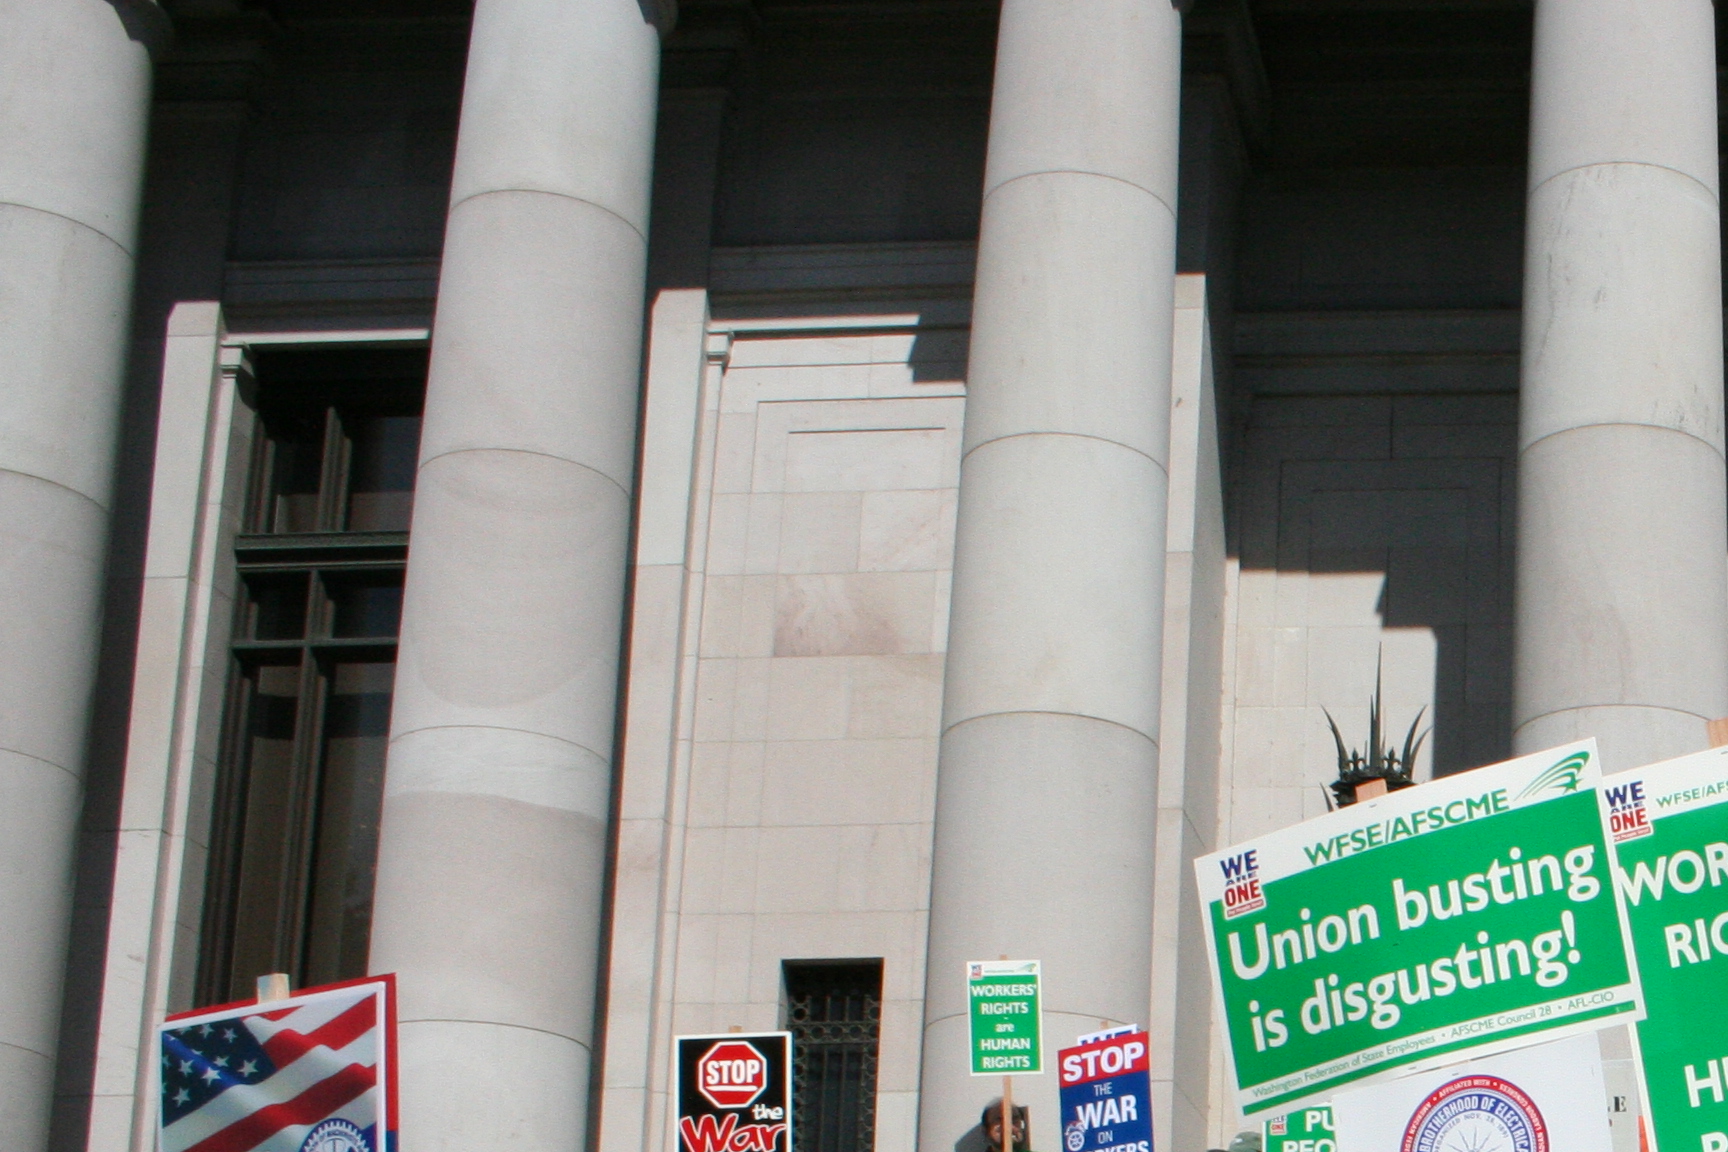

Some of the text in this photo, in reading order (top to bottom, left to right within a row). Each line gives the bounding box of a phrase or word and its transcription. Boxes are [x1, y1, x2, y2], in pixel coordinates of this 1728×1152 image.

[1605, 781, 1645, 809] WE
[1303, 788, 1509, 867] WFSE/AFSCME
[1610, 808, 1648, 834] ONE
[1220, 849, 1259, 879] WE
[1225, 879, 1261, 907] ONE
[1228, 844, 1601, 982] Union busting
[1249, 910, 1581, 1053] is disgusting!
[980, 1002, 1028, 1014] RIGHTS
[1450, 990, 1615, 1039] AFSCME Council 28 AFL-CIO
[995, 1023, 1014, 1032] are
[981, 1038, 1030, 1050] HUMAN
[706, 1059, 760, 1085] STOP
[982, 1056, 1030, 1068] RIGHTS
[1063, 1042, 1144, 1082] STOP
[1304, 1060, 1351, 1083] Federation
[1386, 1034, 1436, 1056] Employees
[1094, 1082, 1112, 1096] THE
[752, 1104, 784, 1120] the
[1076, 1095, 1137, 1130] WAR
[1420, 1096, 1479, 1152] BROTHERHOOD
[1481, 1097, 1497, 1111] OF
[1098, 1130, 1113, 1143] ON
